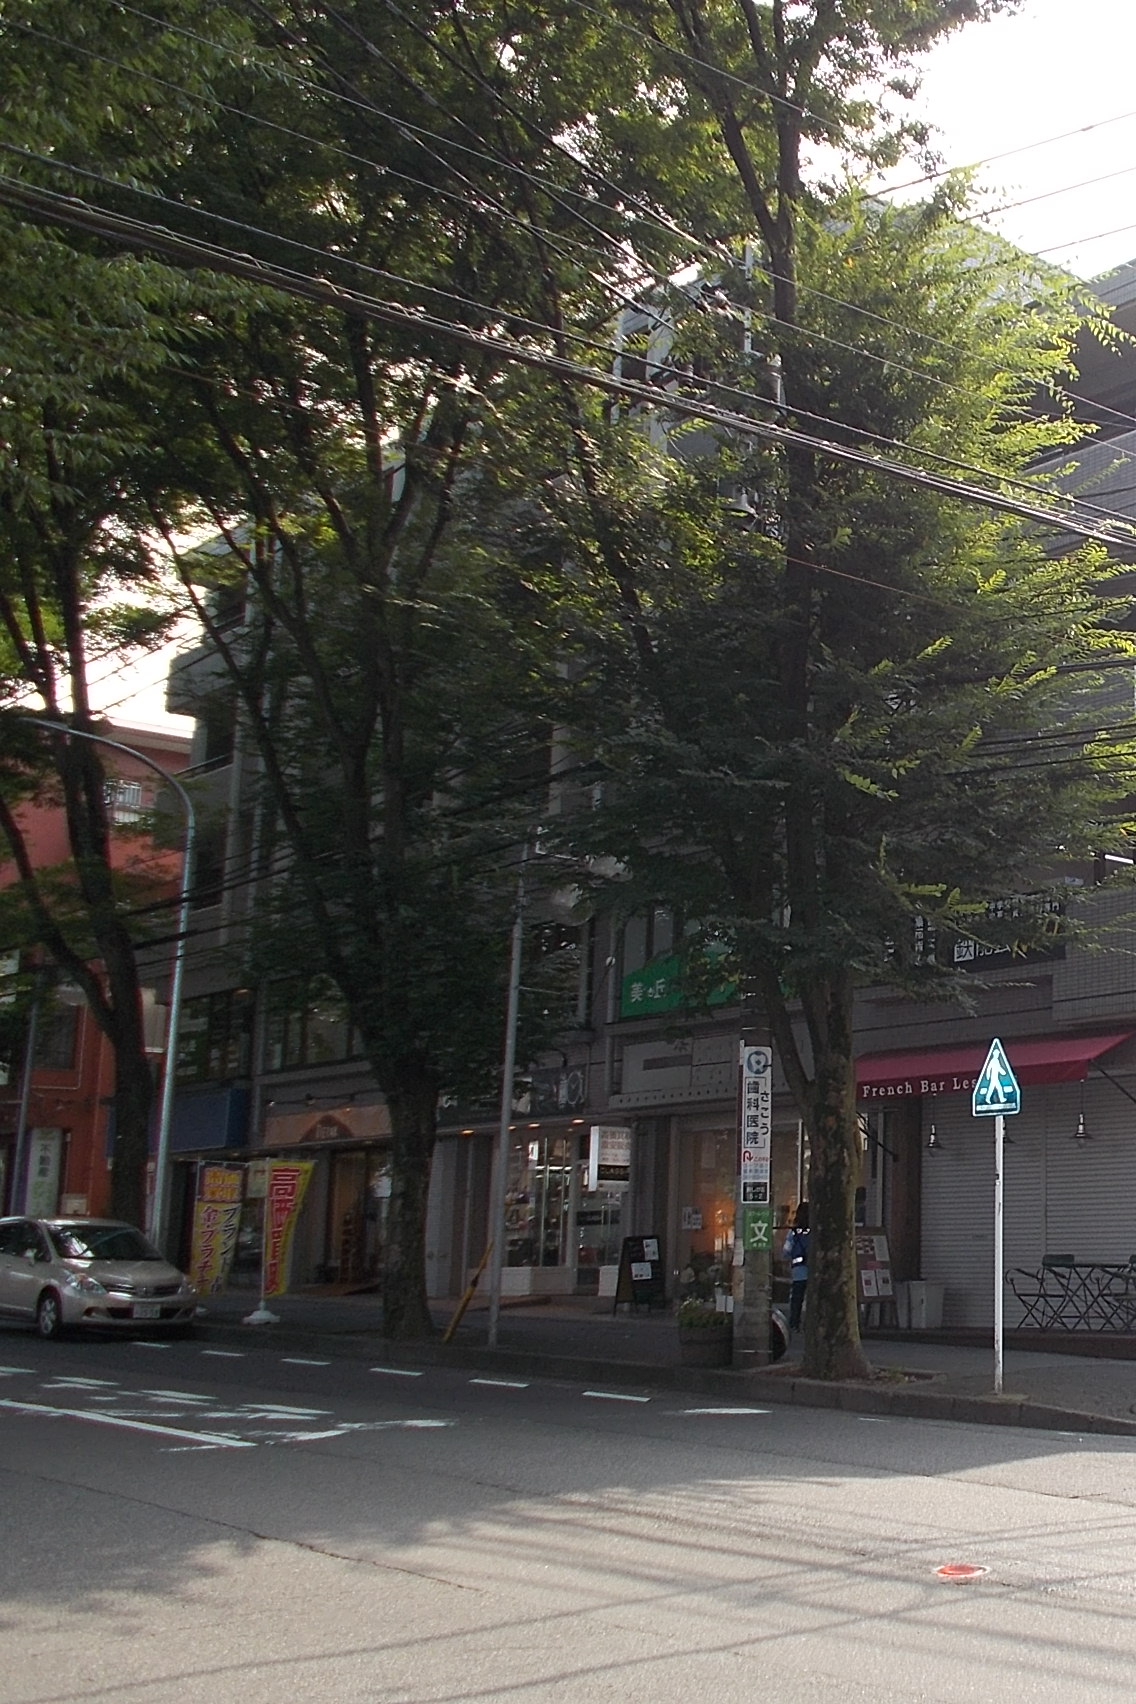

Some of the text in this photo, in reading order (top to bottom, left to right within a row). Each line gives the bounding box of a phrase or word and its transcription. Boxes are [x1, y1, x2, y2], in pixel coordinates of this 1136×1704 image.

[862, 1077, 976, 1098] French Bar Les
[747, 1081, 759, 1145] 歯科医院
[750, 1220, 768, 1242] 文
